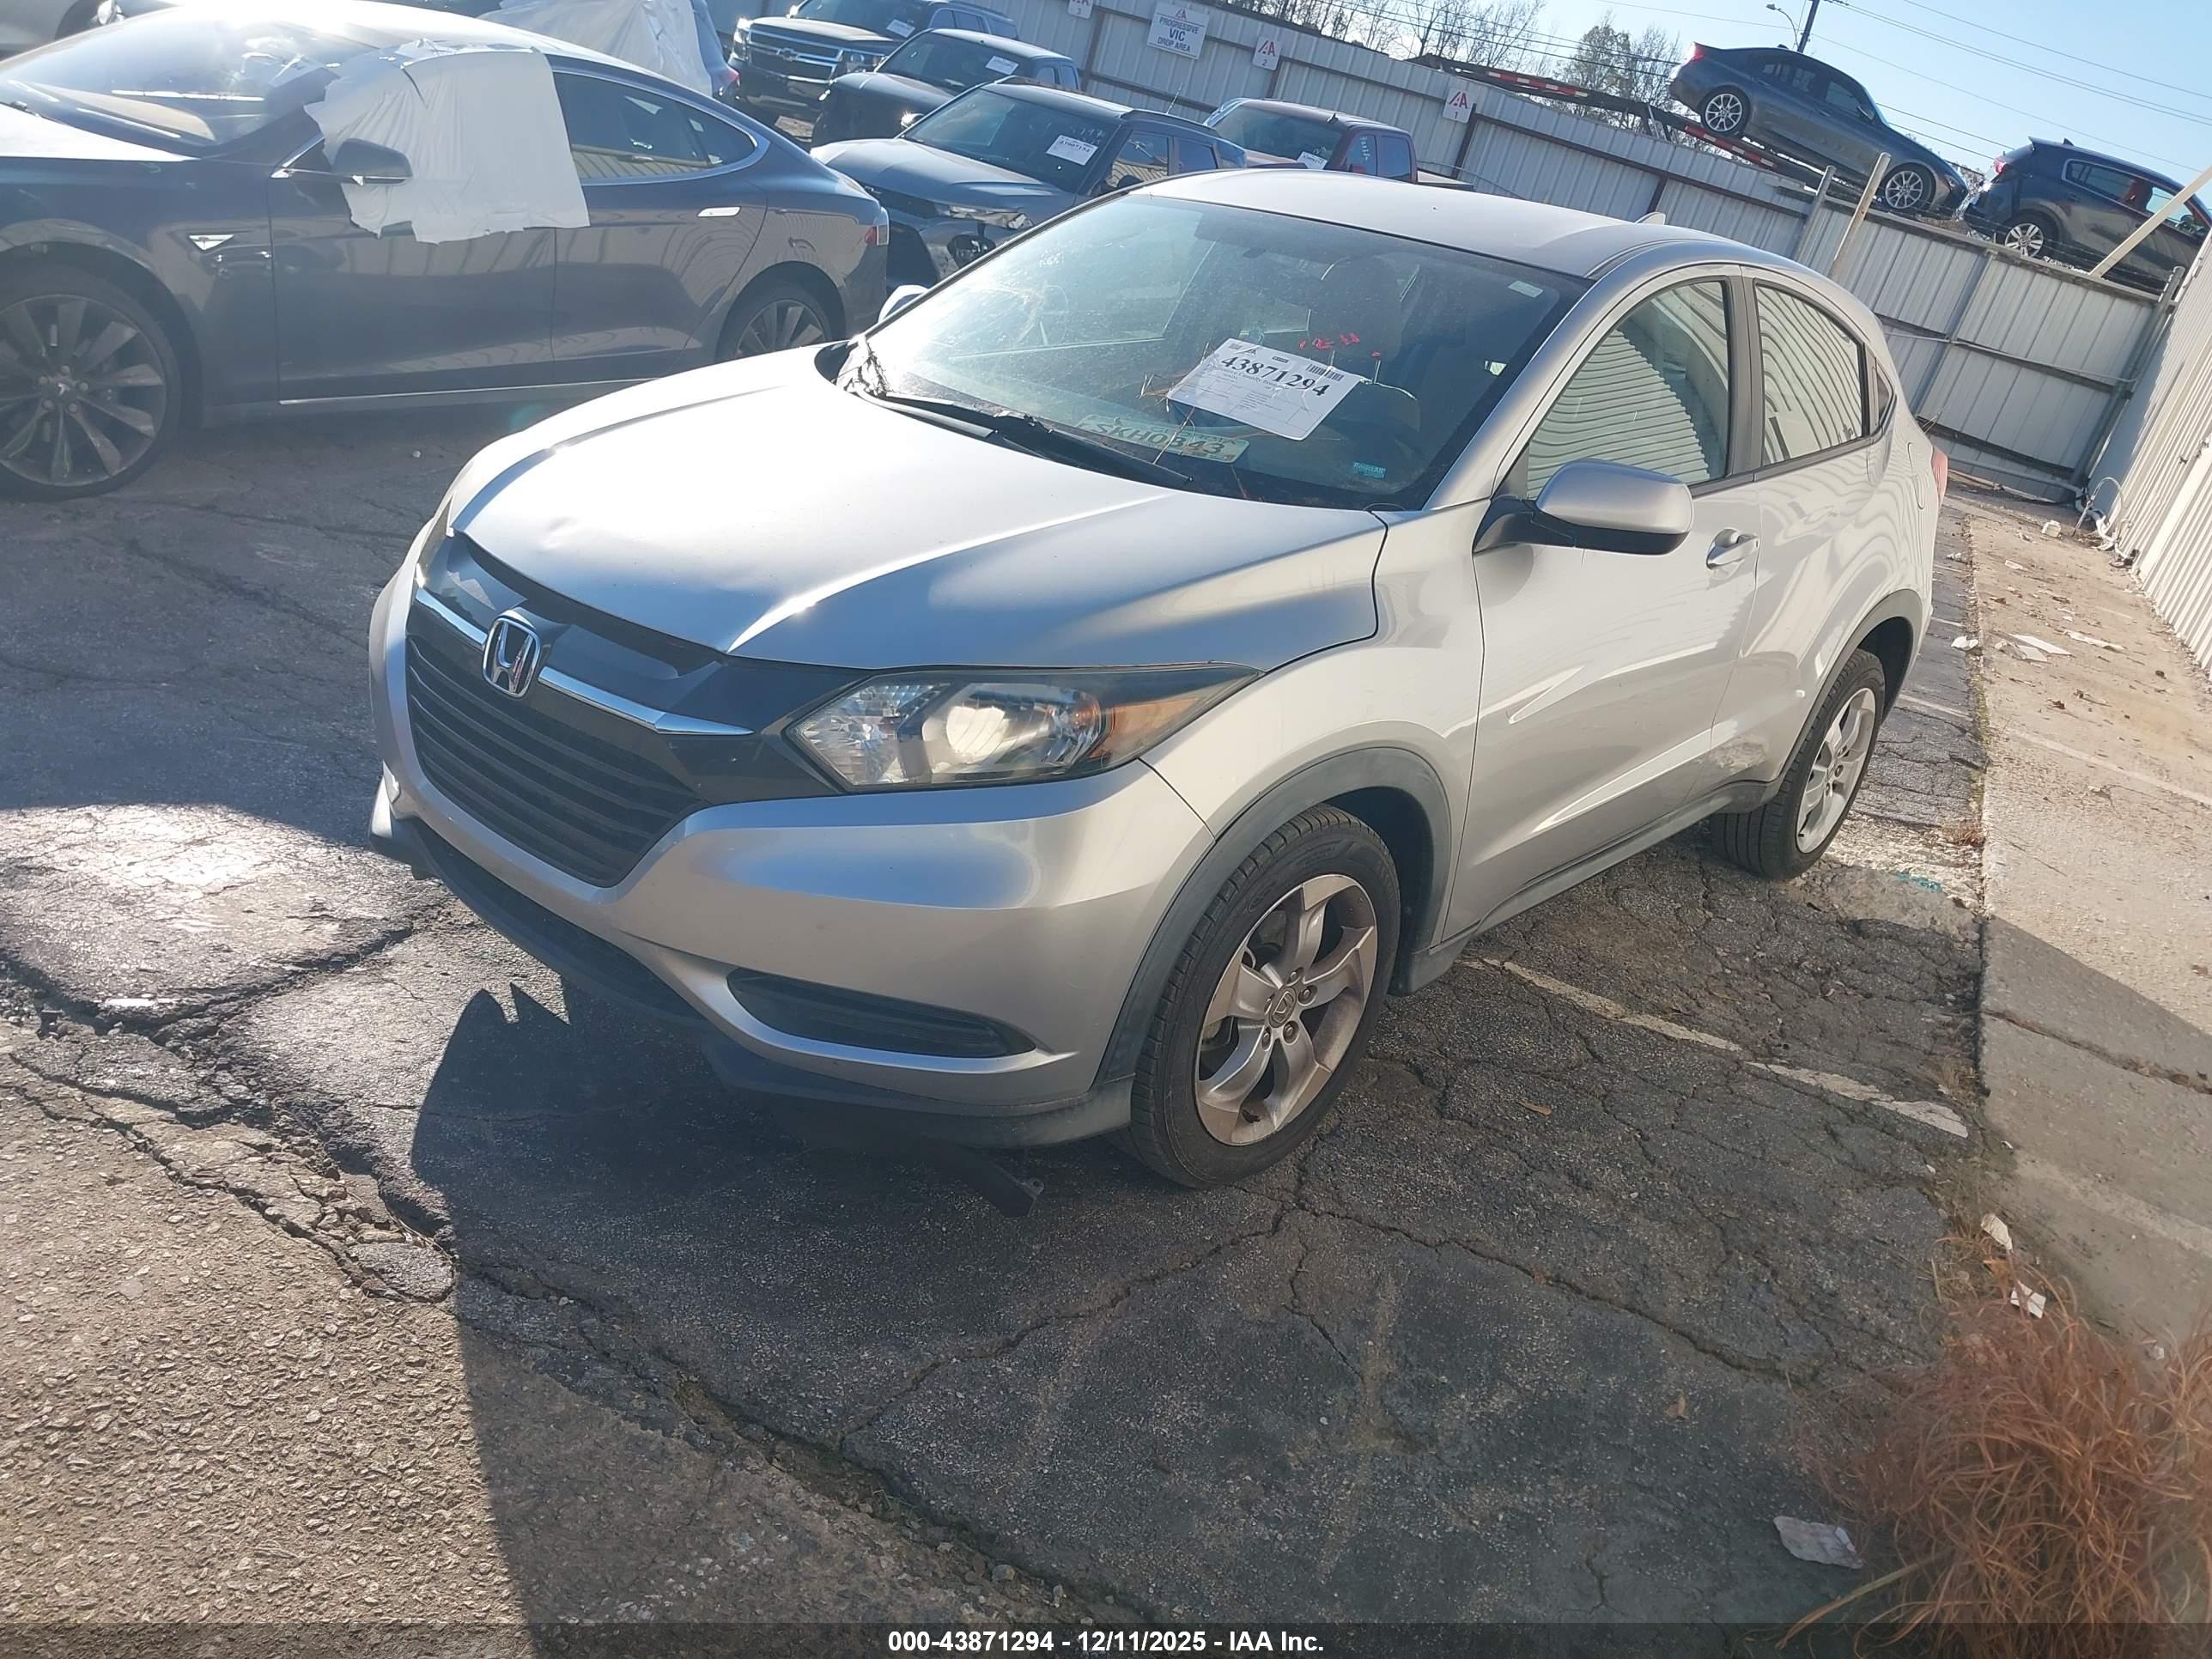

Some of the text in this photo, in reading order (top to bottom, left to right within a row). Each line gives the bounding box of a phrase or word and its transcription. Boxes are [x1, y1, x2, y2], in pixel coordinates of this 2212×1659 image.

[1159, 16, 1200, 34] PROGRESSIVE
[1170, 27, 1186, 42] VIC
[1157, 36, 1191, 52] DROP AREA
[1221, 356, 1331, 396] 43871294
